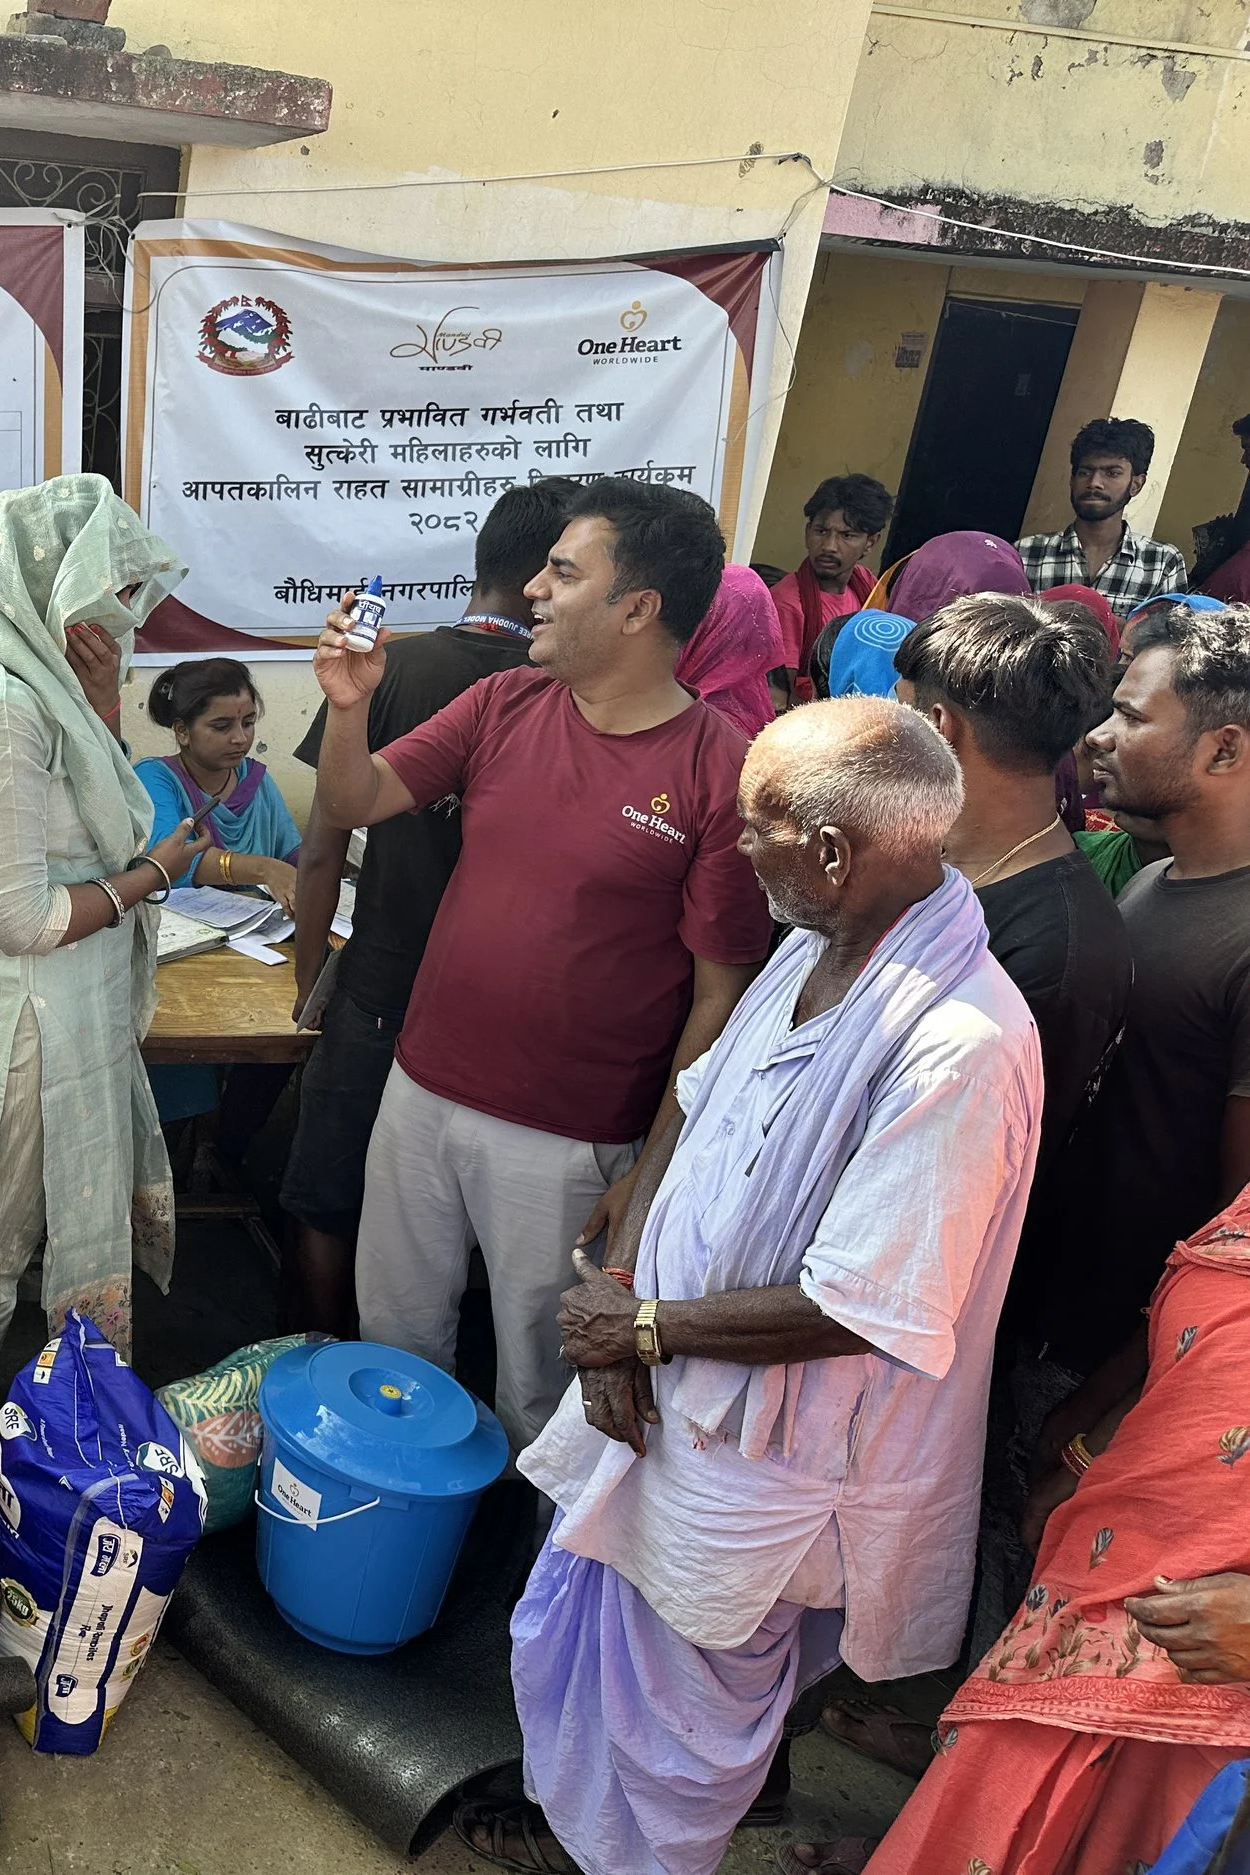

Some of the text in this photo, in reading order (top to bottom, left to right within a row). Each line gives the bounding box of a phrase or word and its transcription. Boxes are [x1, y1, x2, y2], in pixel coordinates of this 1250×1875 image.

[577, 335, 682, 356] One Heart
[592, 356, 659, 365] WORLDWIDE
[275, 398, 625, 430] बाढीबाट प्रभावित गर्भवती तथा
[304, 431, 592, 471] सुत्केरी महिलाहरुको लागि
[182, 473, 321, 501] आपतकालिन
[332, 479, 390, 500] राहत
[400, 470, 517, 499] सामाग्रीहरु
[408, 511, 478, 535] २०८२
[382, 574, 476, 601] नगरपालि
[488, 615, 518, 631] JUDDHA
[621, 805, 686, 844] One Heart
[630, 822, 674, 844] WORLDWIDE
[4, 1407, 19, 1430] SRF
[154, 1448, 179, 1474] SRF
[277, 1484, 290, 1500] One
[290, 1496, 311, 1517] Heart
[7, 1590, 29, 1616] 25kg
